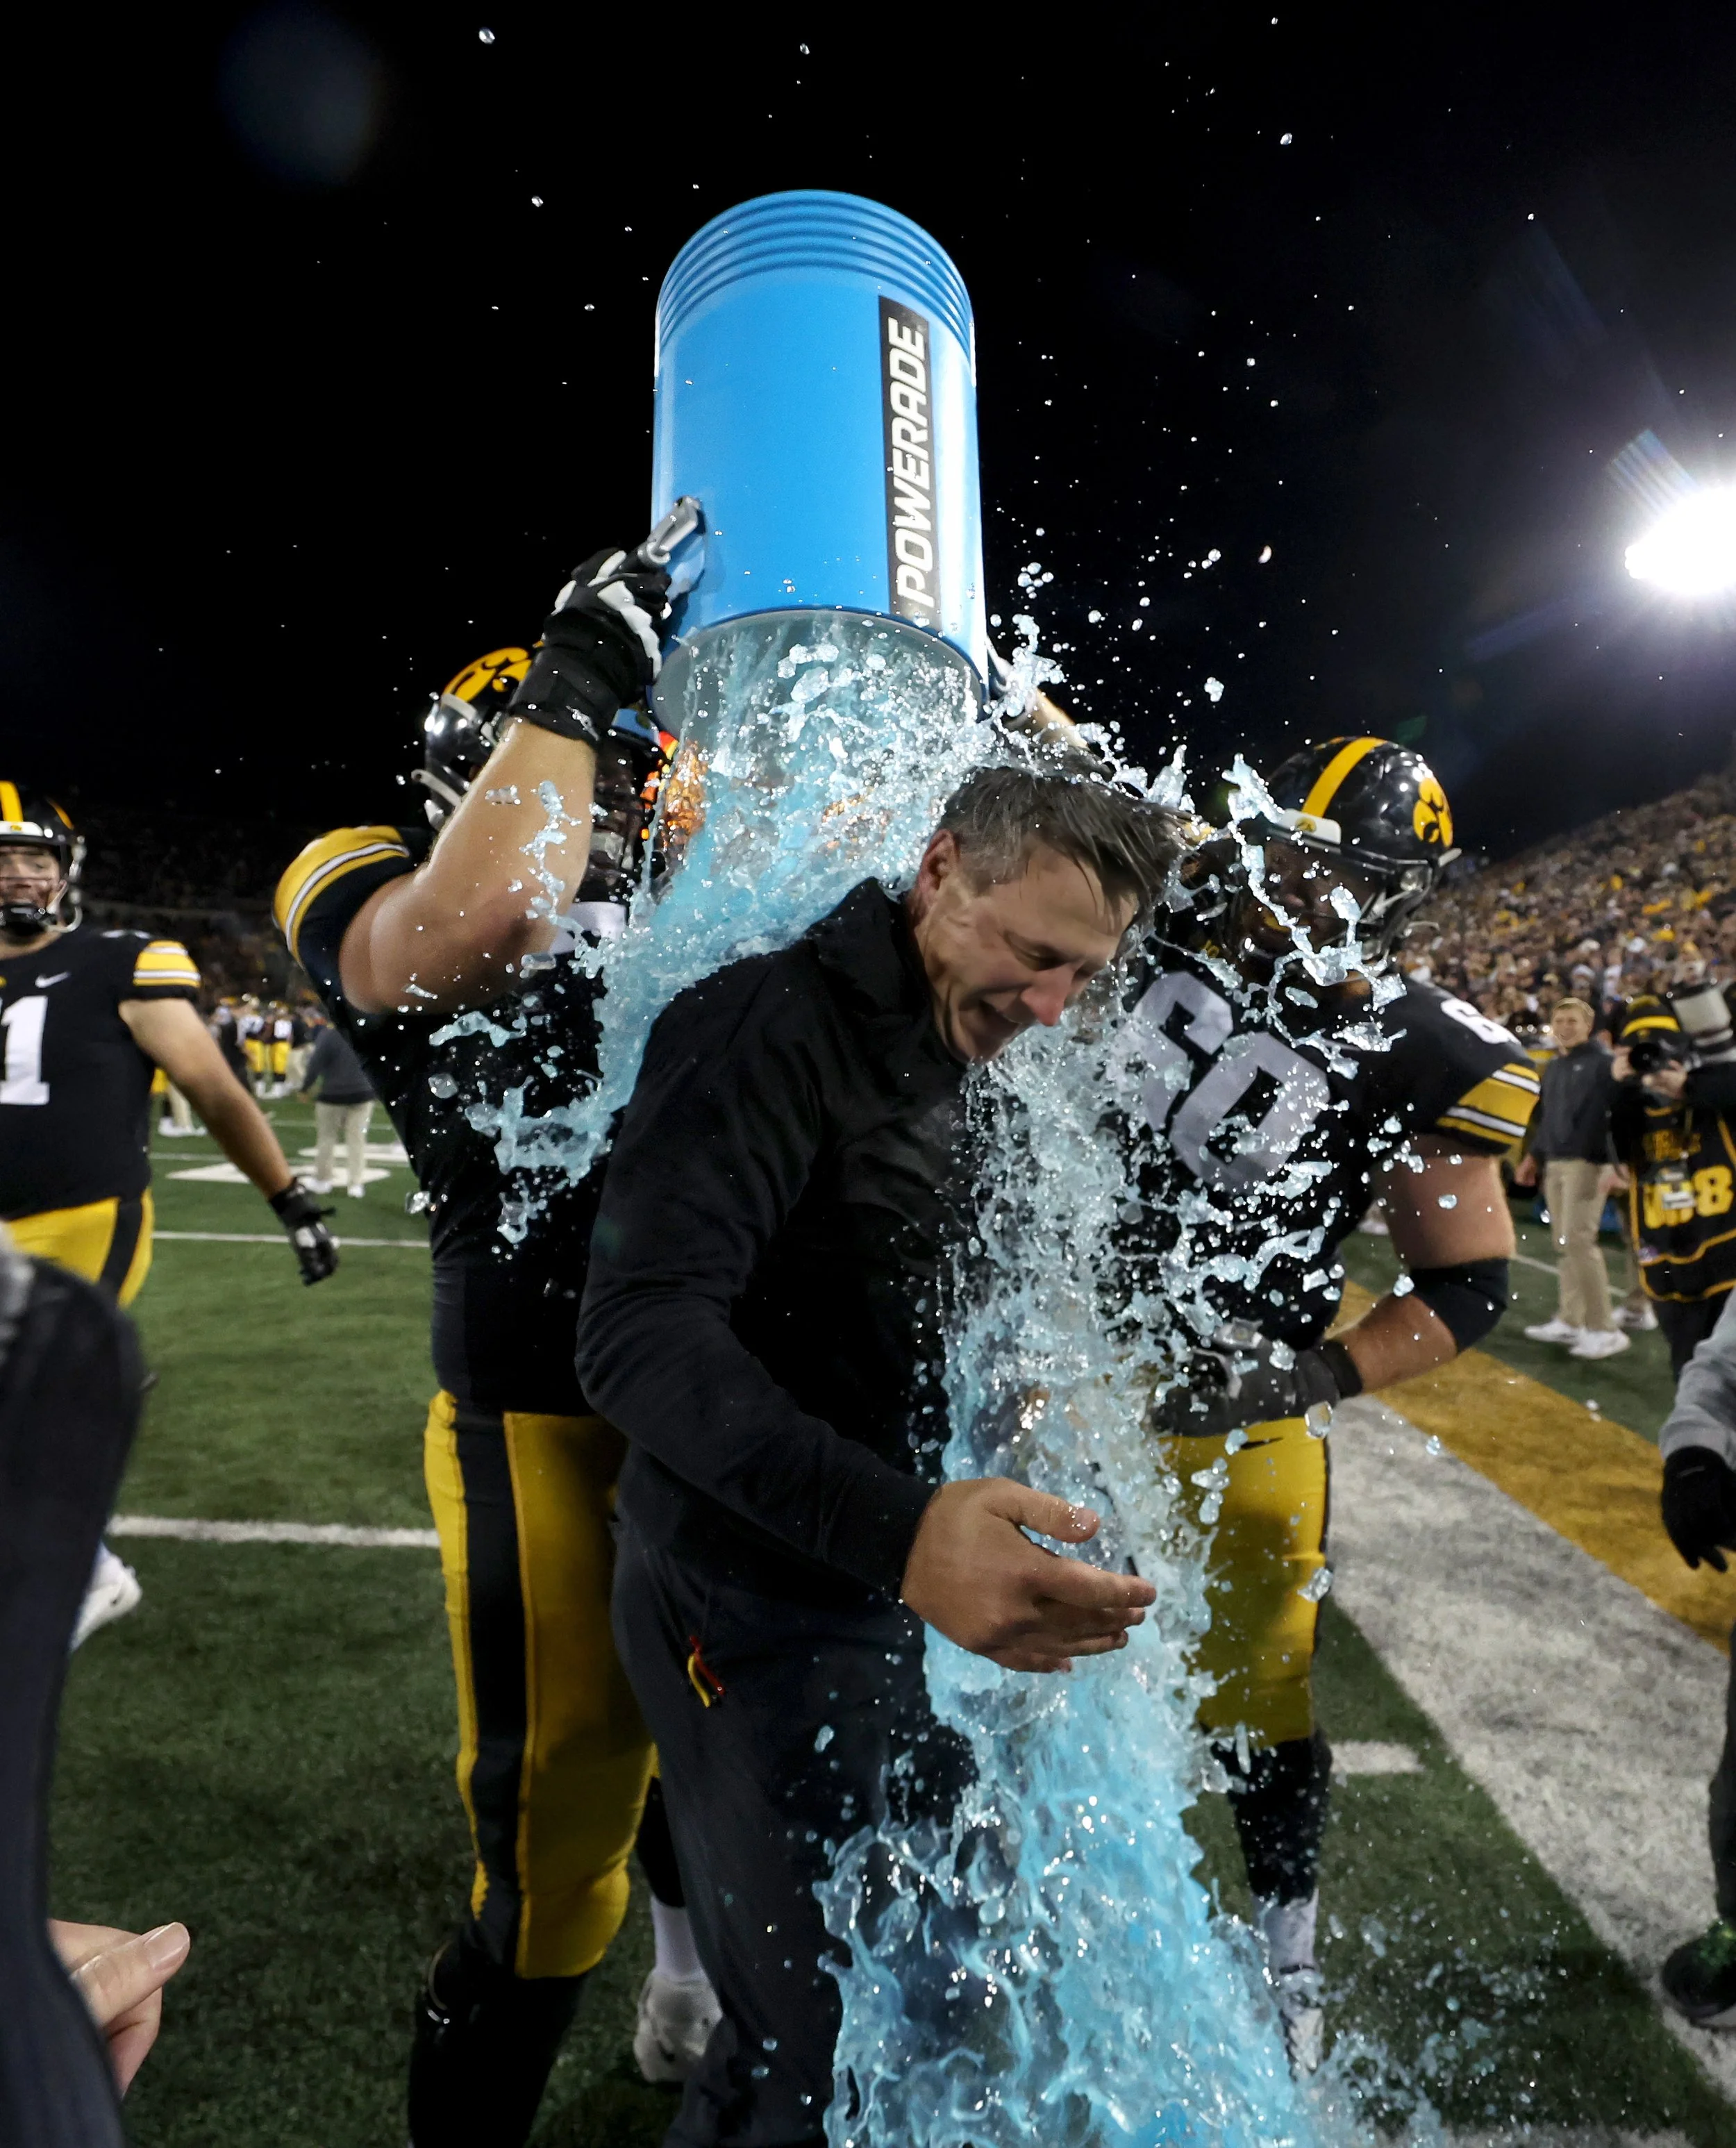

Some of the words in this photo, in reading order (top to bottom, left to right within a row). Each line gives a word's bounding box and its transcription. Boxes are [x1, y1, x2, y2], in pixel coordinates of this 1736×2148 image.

[888, 317, 935, 607] POWERADE
[0, 995, 50, 1106] 1
[1116, 971, 1330, 1196] 60
